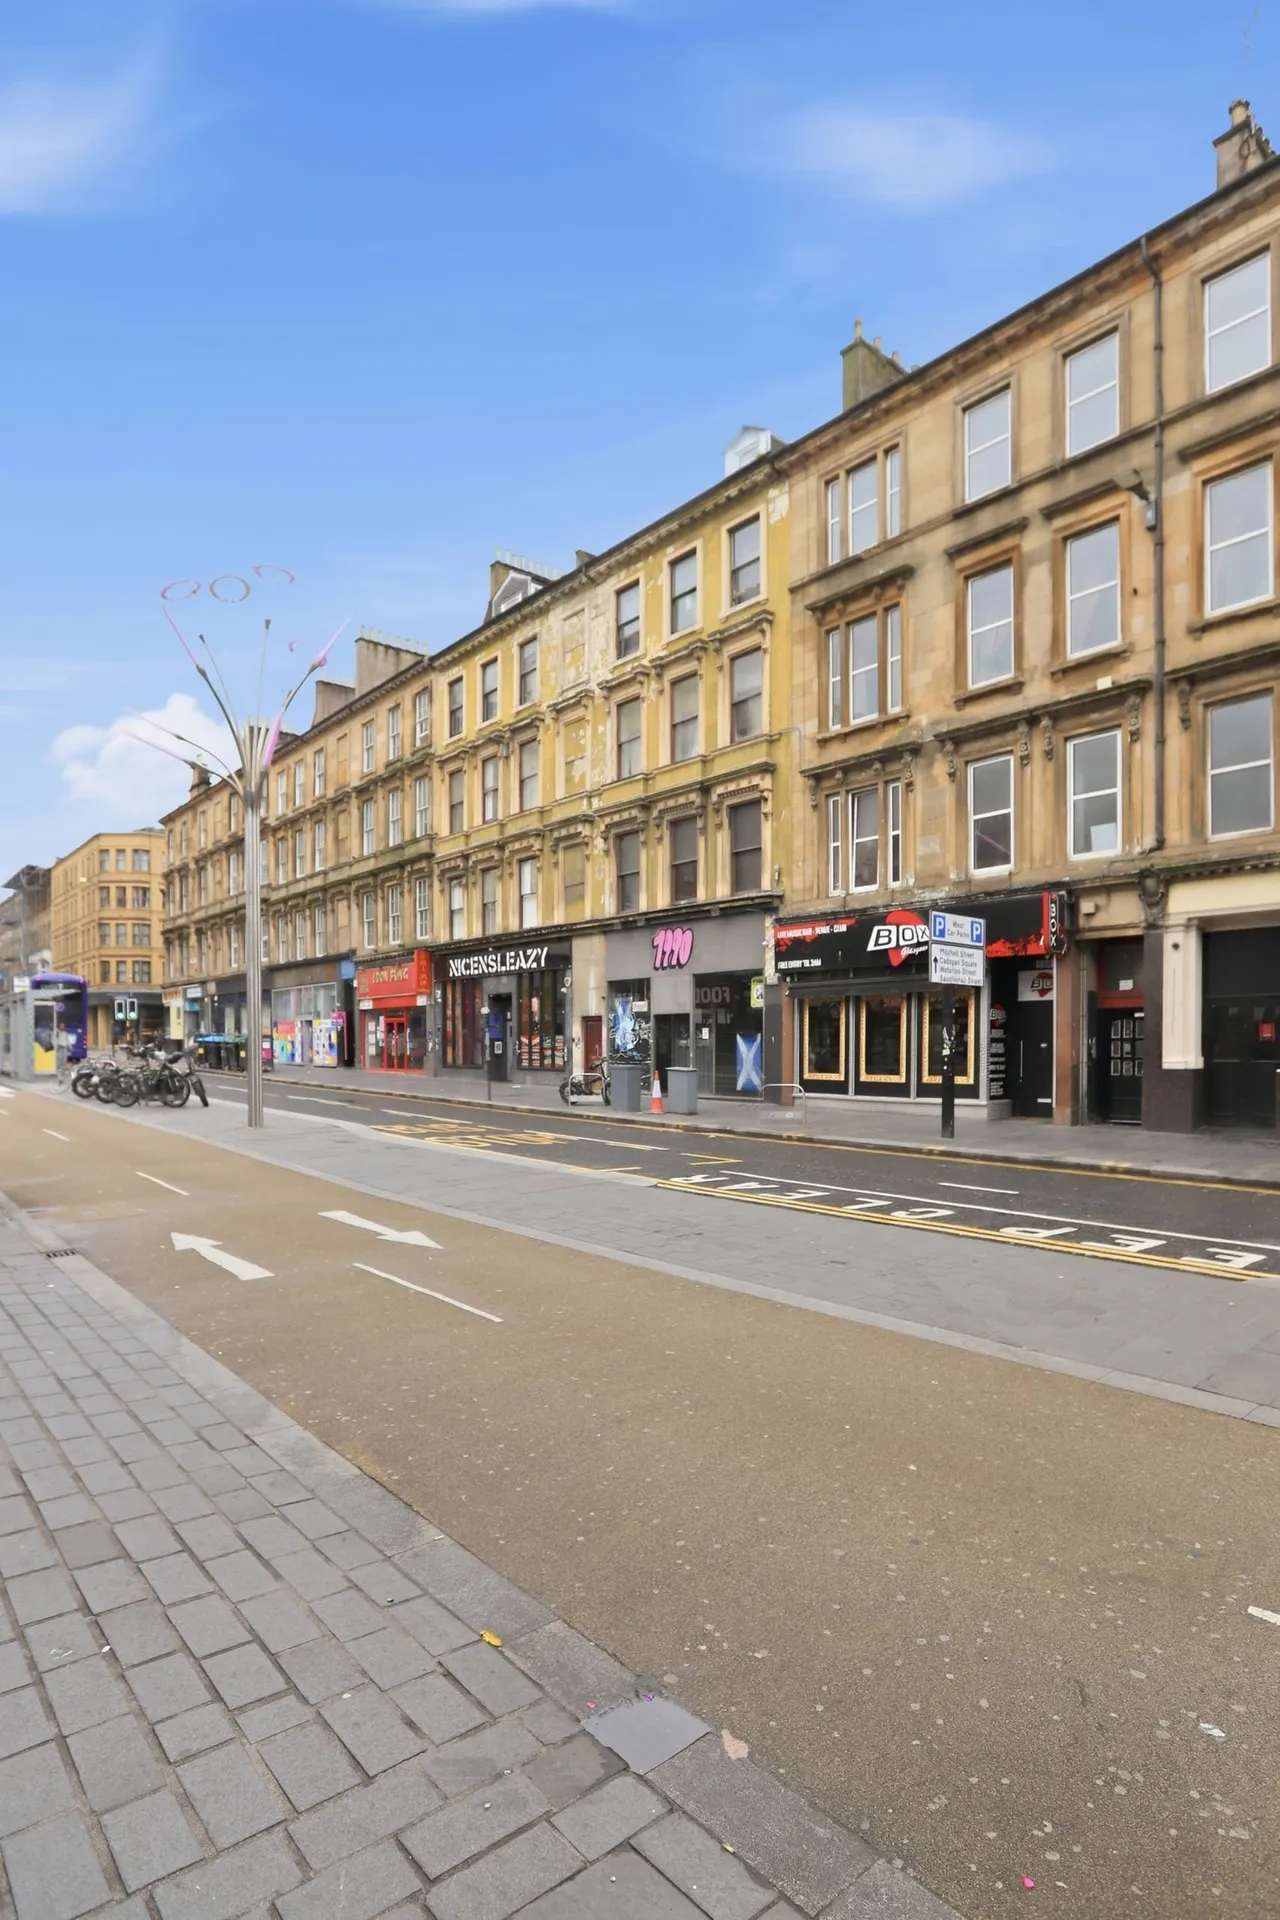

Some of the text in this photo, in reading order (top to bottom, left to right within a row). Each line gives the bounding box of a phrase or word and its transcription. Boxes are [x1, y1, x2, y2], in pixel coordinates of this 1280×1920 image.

[868, 924, 930, 951] BOX
[652, 927, 694, 970] 1990
[940, 948, 975, 959] Mitchell Street
[777, 961, 788, 970] FREE
[788, 960, 803, 969] ENTRY
[940, 957, 978, 968] Cadogan Square
[940, 966, 977, 976] Waterloo Street
[968, 977, 982, 985] Street
[671, 1173, 955, 1221] CLEAR
